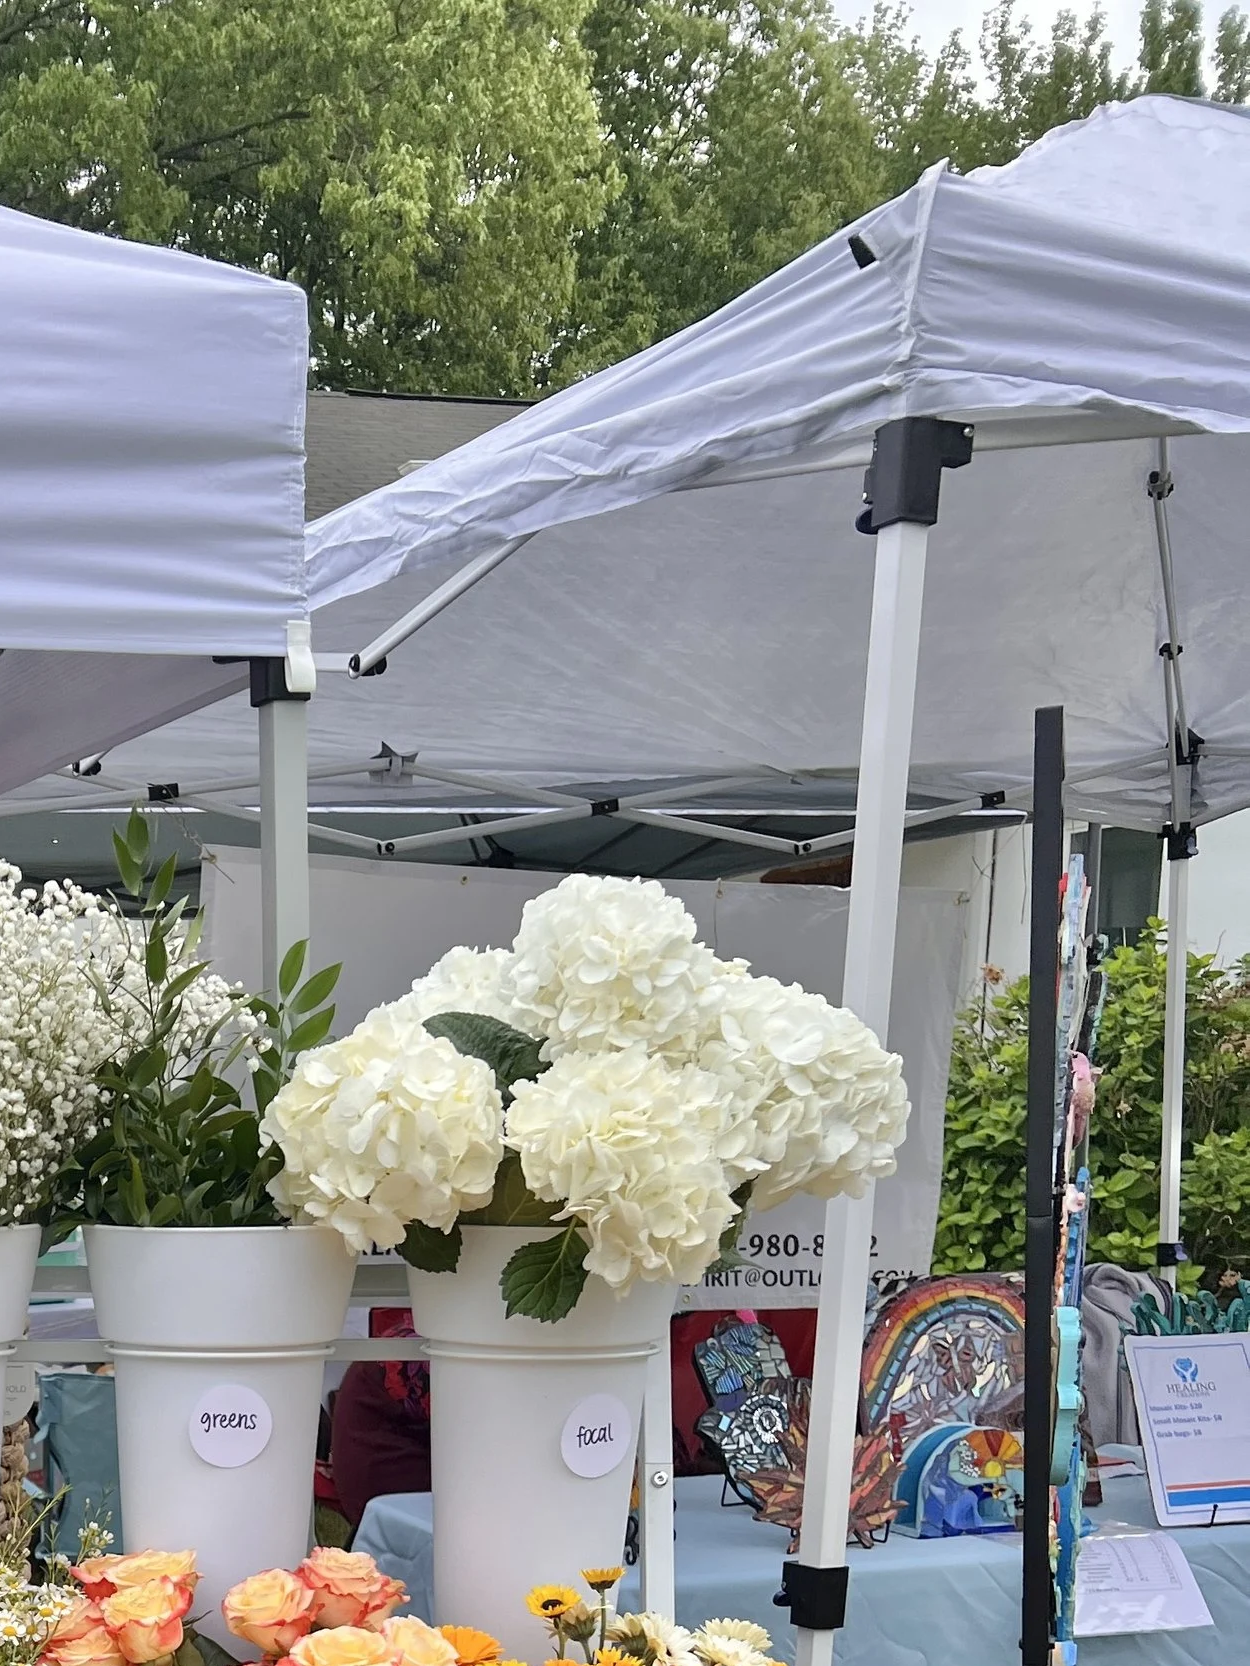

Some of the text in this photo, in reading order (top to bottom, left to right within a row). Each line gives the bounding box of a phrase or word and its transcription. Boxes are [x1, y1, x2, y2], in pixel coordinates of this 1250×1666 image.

[1166, 1381, 1217, 1394] HEALING
[200, 1412, 258, 1434] greens
[576, 1422, 614, 1449] focal
